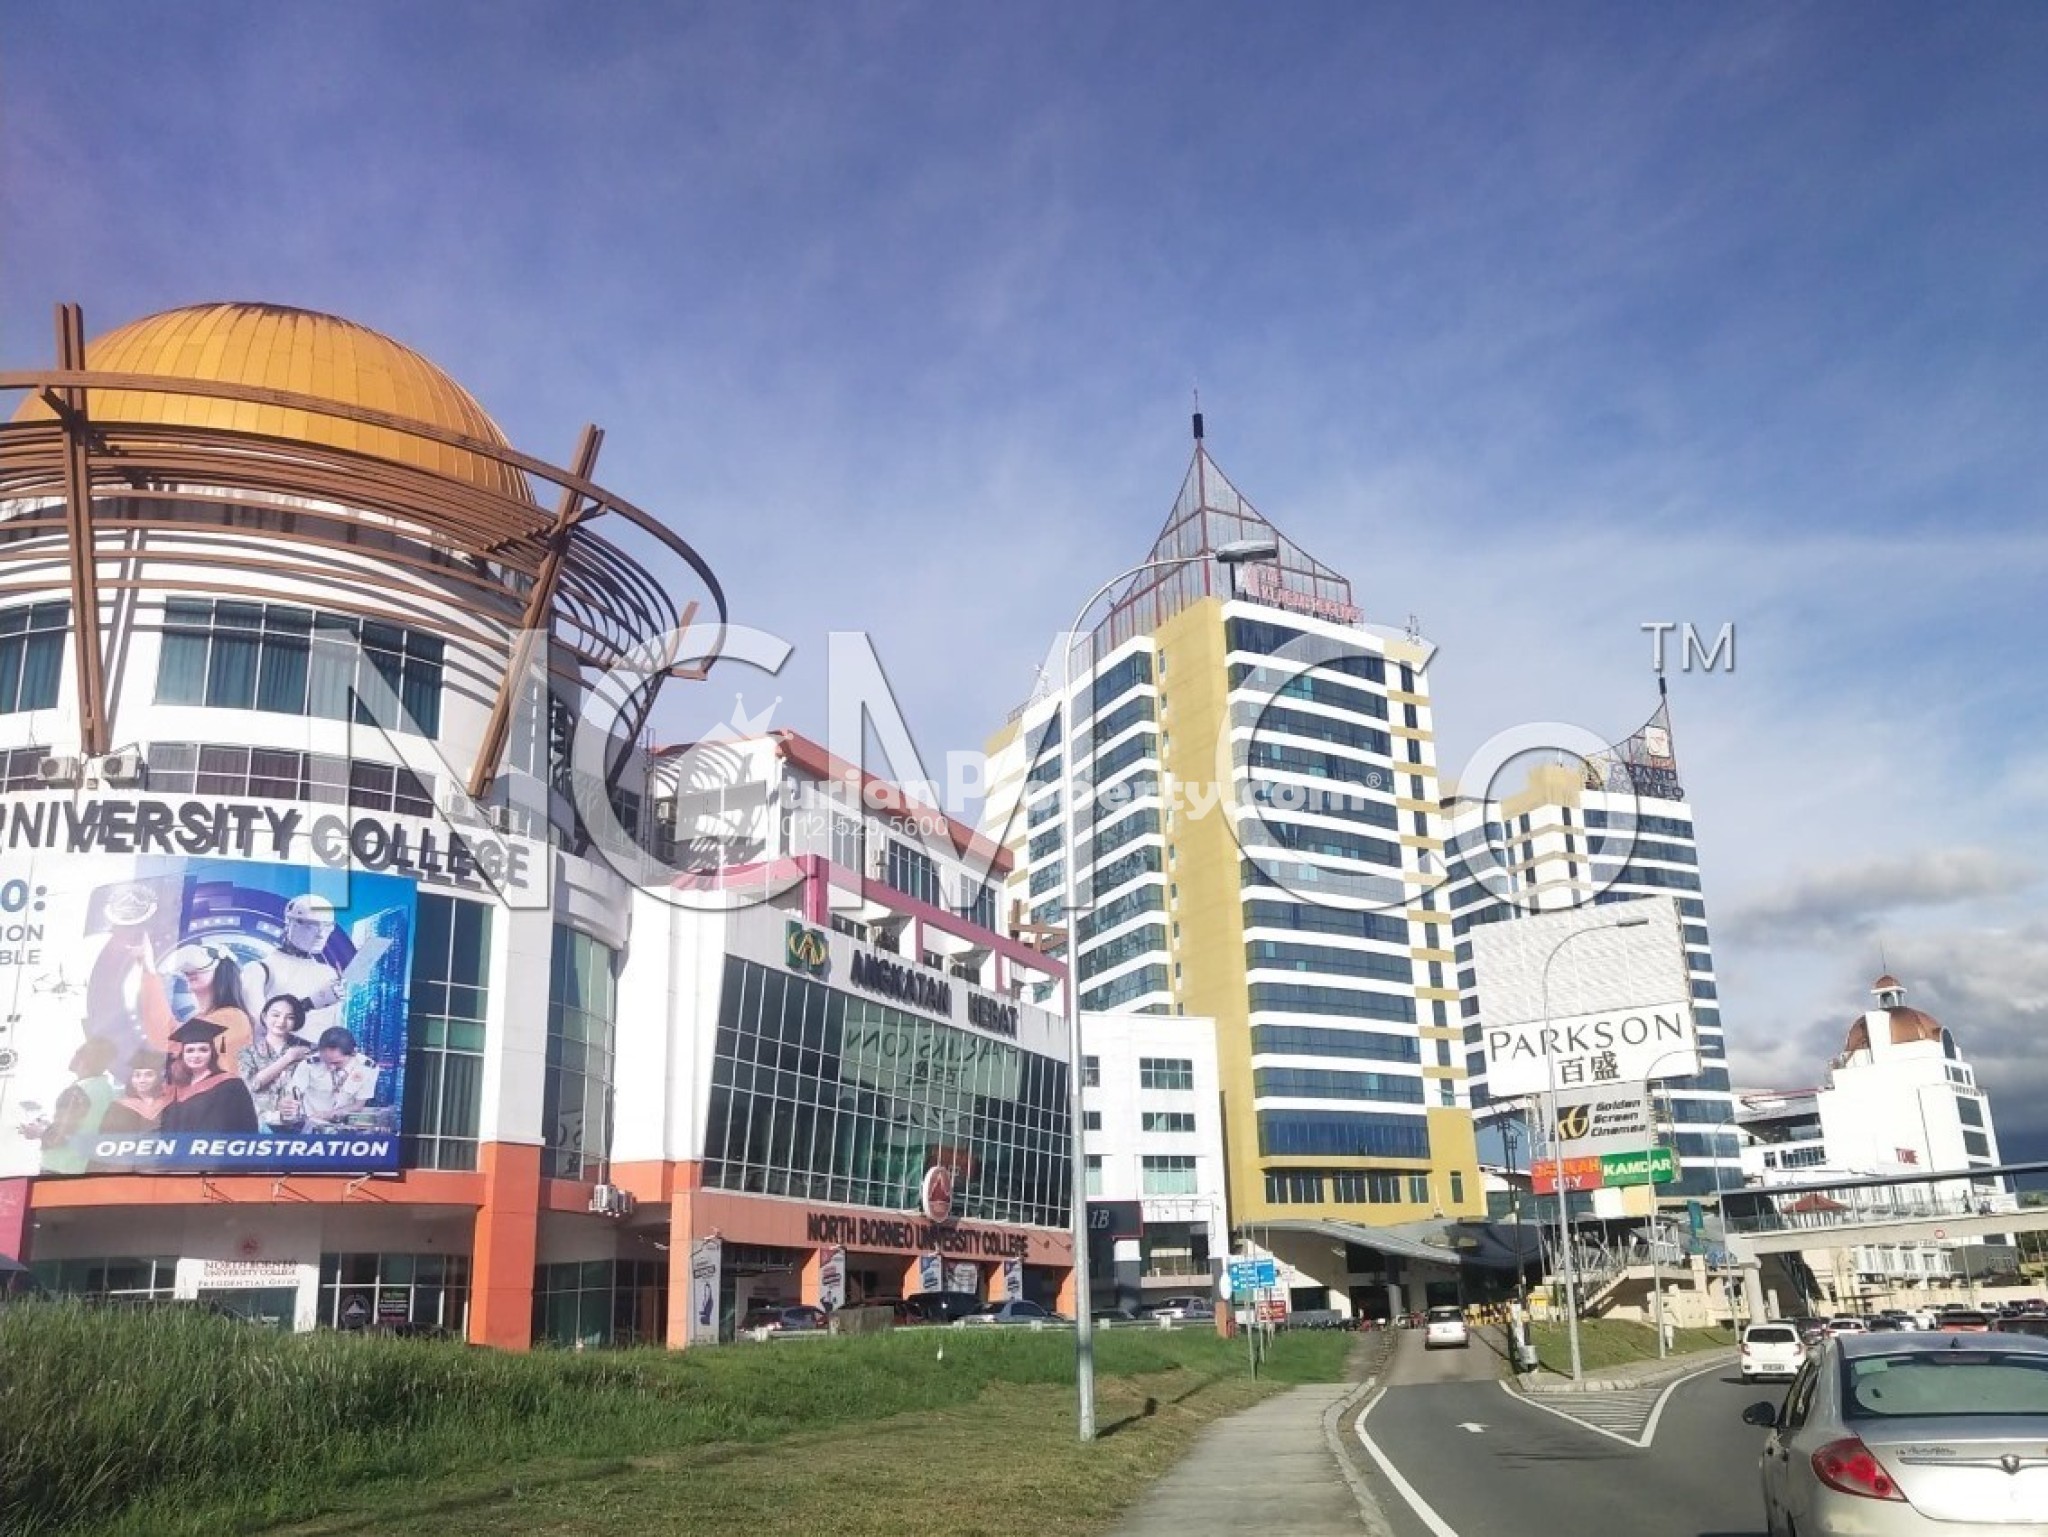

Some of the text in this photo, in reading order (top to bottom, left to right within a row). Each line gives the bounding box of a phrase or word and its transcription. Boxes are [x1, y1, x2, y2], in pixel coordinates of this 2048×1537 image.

[0, 800, 530, 890] NIVERSITY COLLEGE
[850, 949, 1019, 1039] ANGKATAN HEBAT
[1489, 1012, 1683, 1062] PARKSON
[1556, 1050, 1620, 1084] 百盛
[1593, 1112, 1639, 1124] Screen
[1595, 1100, 1641, 1111] Golden
[1591, 1124, 1646, 1136] Cinemas
[95, 1139, 389, 1157] OPEN REGISTRATION
[1603, 1158, 1672, 1177] KAMDAR
[807, 1213, 1028, 1258] NORTH BORNEO UNIVERSITY COLLEGE
